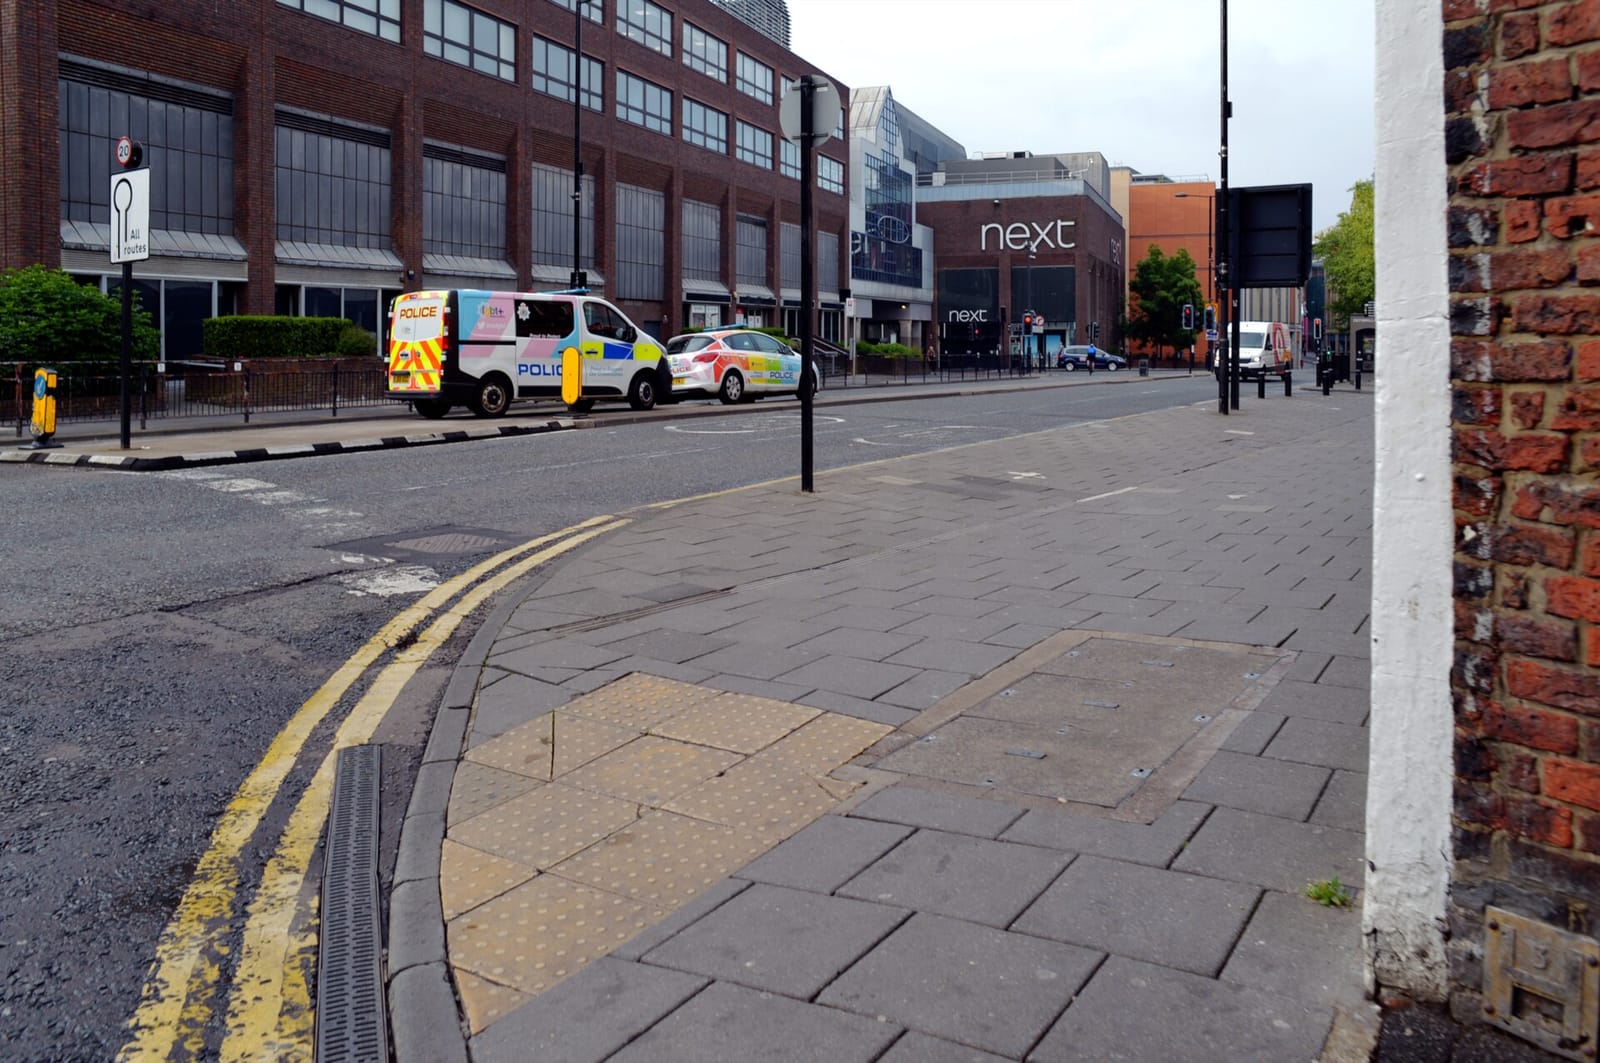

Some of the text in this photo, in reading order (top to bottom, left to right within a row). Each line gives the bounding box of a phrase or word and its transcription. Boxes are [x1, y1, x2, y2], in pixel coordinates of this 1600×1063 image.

[119, 145, 129, 157] 20
[130, 229, 140, 240] All
[981, 219, 1075, 251] next
[123, 243, 147, 255] routes
[399, 306, 438, 319] POLICE
[948, 309, 987, 322] next
[769, 371, 794, 379] POLICE
